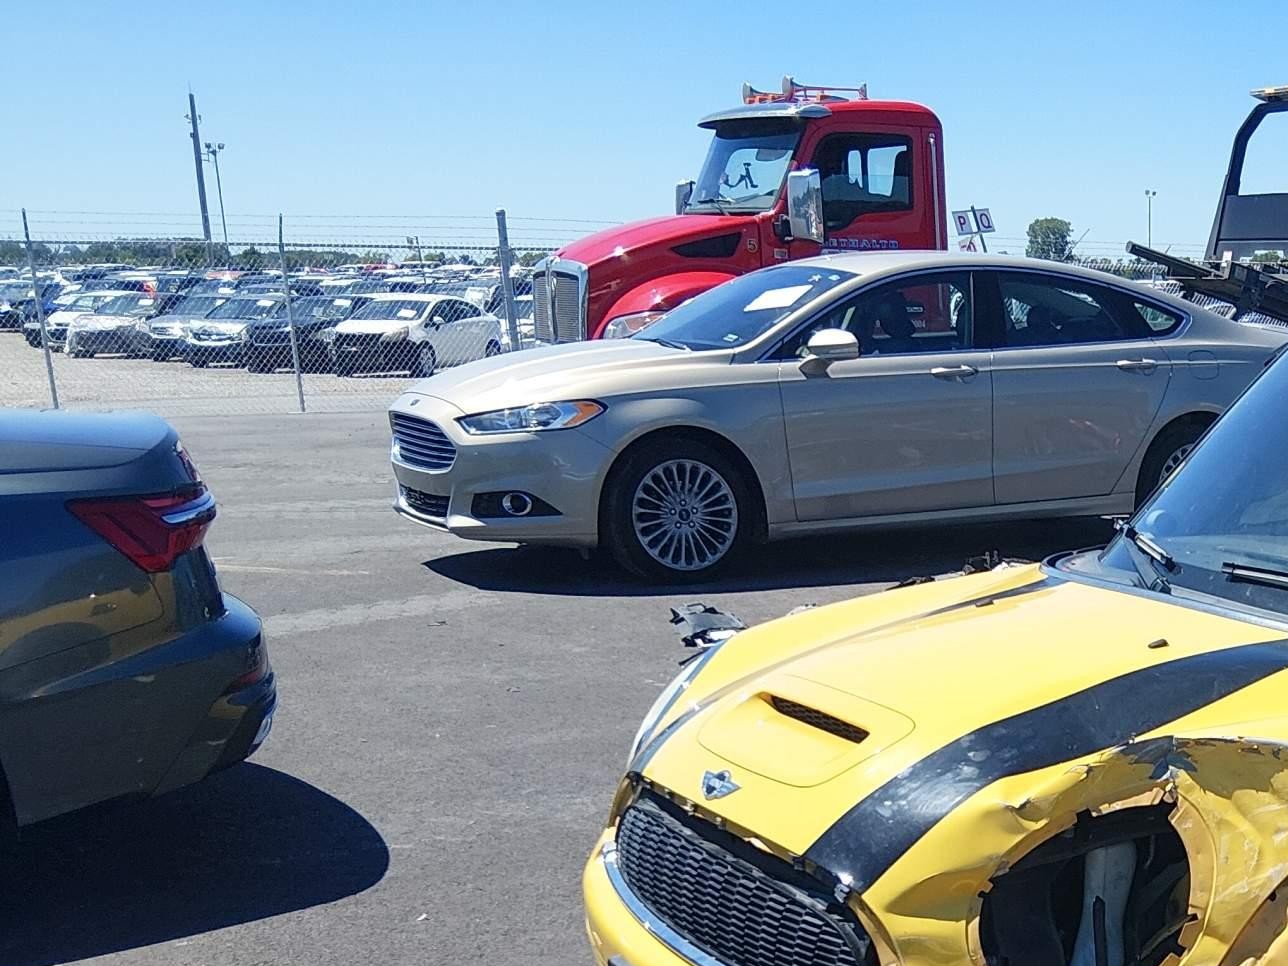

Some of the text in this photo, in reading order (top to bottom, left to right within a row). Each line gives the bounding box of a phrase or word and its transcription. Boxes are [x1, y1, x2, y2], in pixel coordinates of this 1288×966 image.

[957, 215, 967, 232] P
[979, 212, 993, 229] Q
[747, 239, 758, 252] 5
